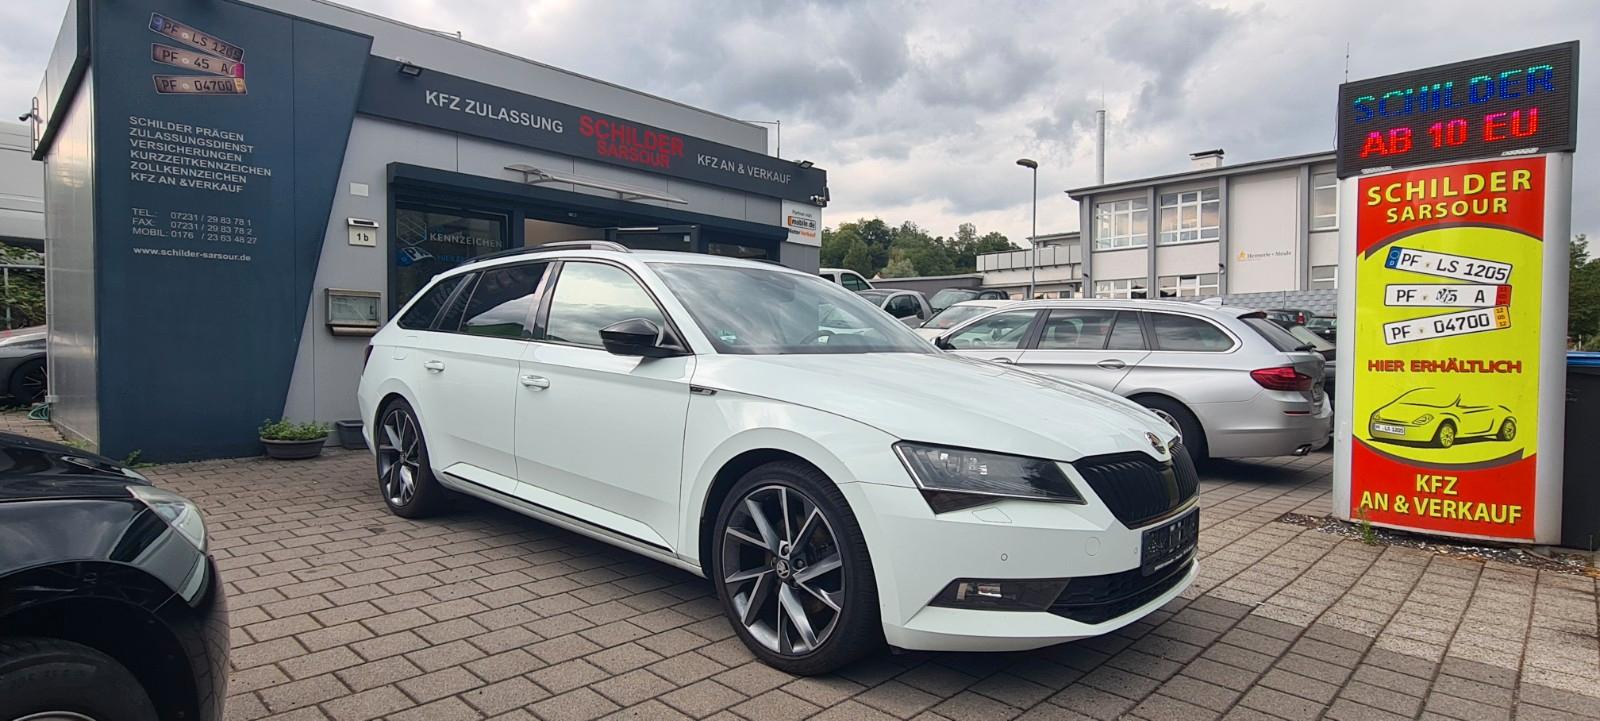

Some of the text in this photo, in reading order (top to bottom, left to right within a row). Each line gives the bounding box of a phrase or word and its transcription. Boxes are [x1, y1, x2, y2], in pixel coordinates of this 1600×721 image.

[164, 22, 179, 34] PF
[192, 32, 207, 46] LS
[162, 50, 178, 61] PF
[194, 57, 210, 69] 45
[220, 63, 229, 74] A
[162, 80, 177, 90] PF
[194, 80, 233, 91] 04700
[1354, 64, 1556, 124] SCHILDER
[426, 90, 564, 134] KFZ ZULASSUNG
[129, 116, 244, 141] SCHILDER PRÄGEN
[129, 127, 254, 153] ZULASSUNGSDIENST
[578, 114, 684, 158] SCHILDER
[1360, 107, 1539, 158] AB 10 EU
[129, 138, 242, 162] VERSICHERUNGEN
[597, 138, 670, 168] SARSOUR
[130, 150, 272, 176] KURZZEITKENNZEICHEN
[130, 161, 246, 183] ZOLLKENNZEICHEN
[697, 153, 792, 185] KFZ AN & VERKAUF
[130, 172, 243, 193] KFZ AN &VERKAUF
[1366, 169, 1532, 206] SCHILDER
[1386, 197, 1508, 223] SARSOUR
[356, 232, 369, 241] 1 b
[430, 232, 502, 248] KENNZEICHEN
[133, 247, 251, 261] www.schilder-sarsour.de
[1401, 253, 1422, 267] PF
[1436, 258, 1459, 273] LS
[1464, 263, 1508, 281] 1205
[1396, 290, 1417, 302] PF
[1474, 289, 1485, 303] A
[1392, 313, 1490, 340] PF 04700
[1367, 357, 1522, 373] HIER ERHÄLTLICH
[1416, 474, 1458, 495] KFZ
[1360, 490, 1522, 524] AN & VERKAUF
